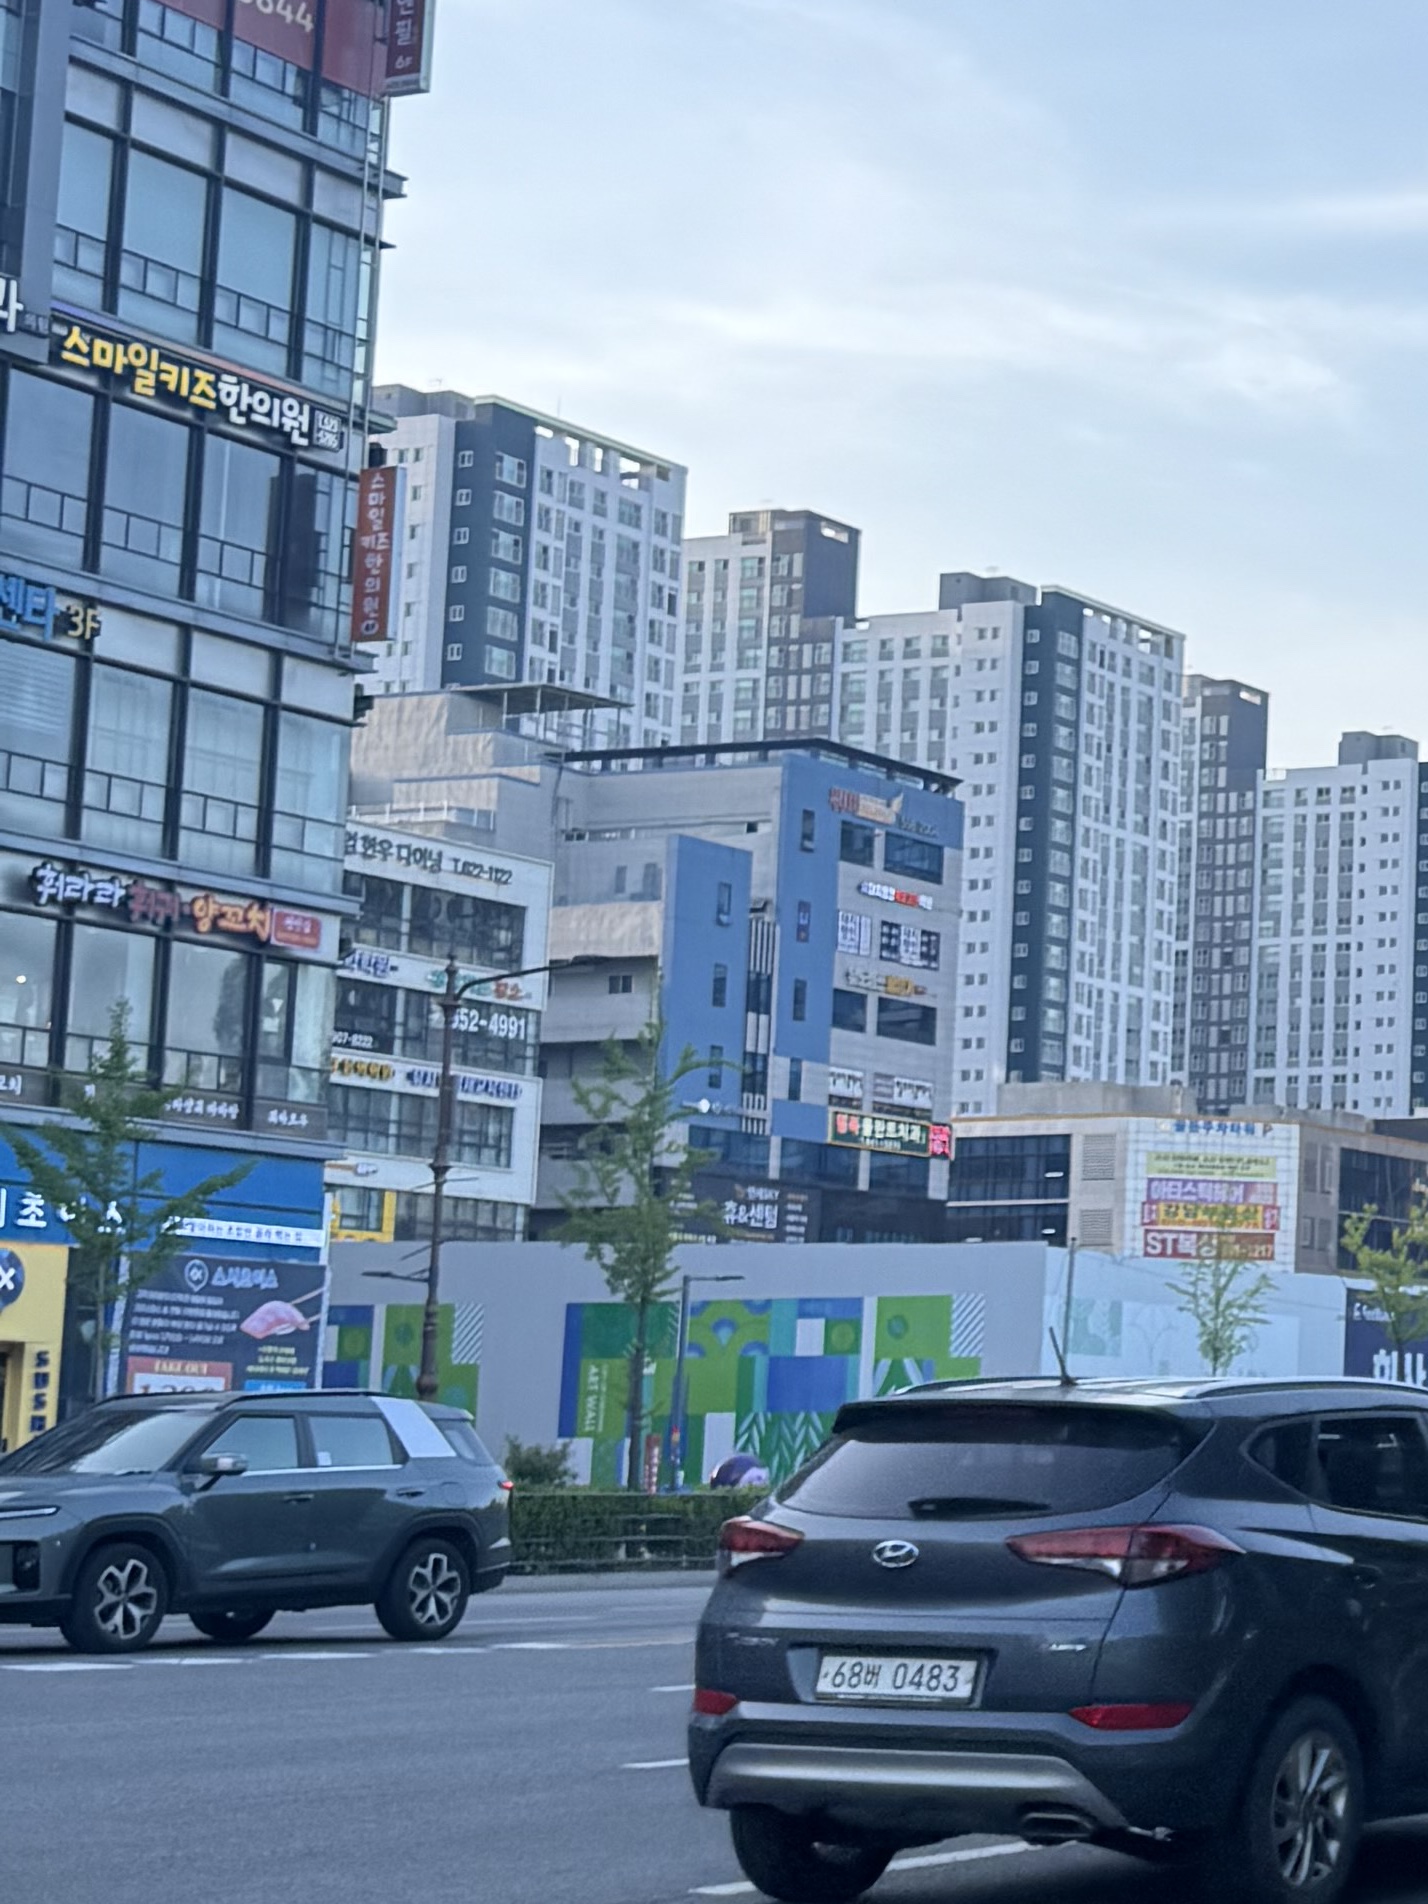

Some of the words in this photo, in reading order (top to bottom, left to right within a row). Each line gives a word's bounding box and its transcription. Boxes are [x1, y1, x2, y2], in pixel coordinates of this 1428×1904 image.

[61, 325, 309, 446] 스마일키즈한의원
[361, 472, 390, 618] 스마일키즈한의원
[67, 604, 100, 640] 3F
[891, 1662, 961, 1693] 0483
